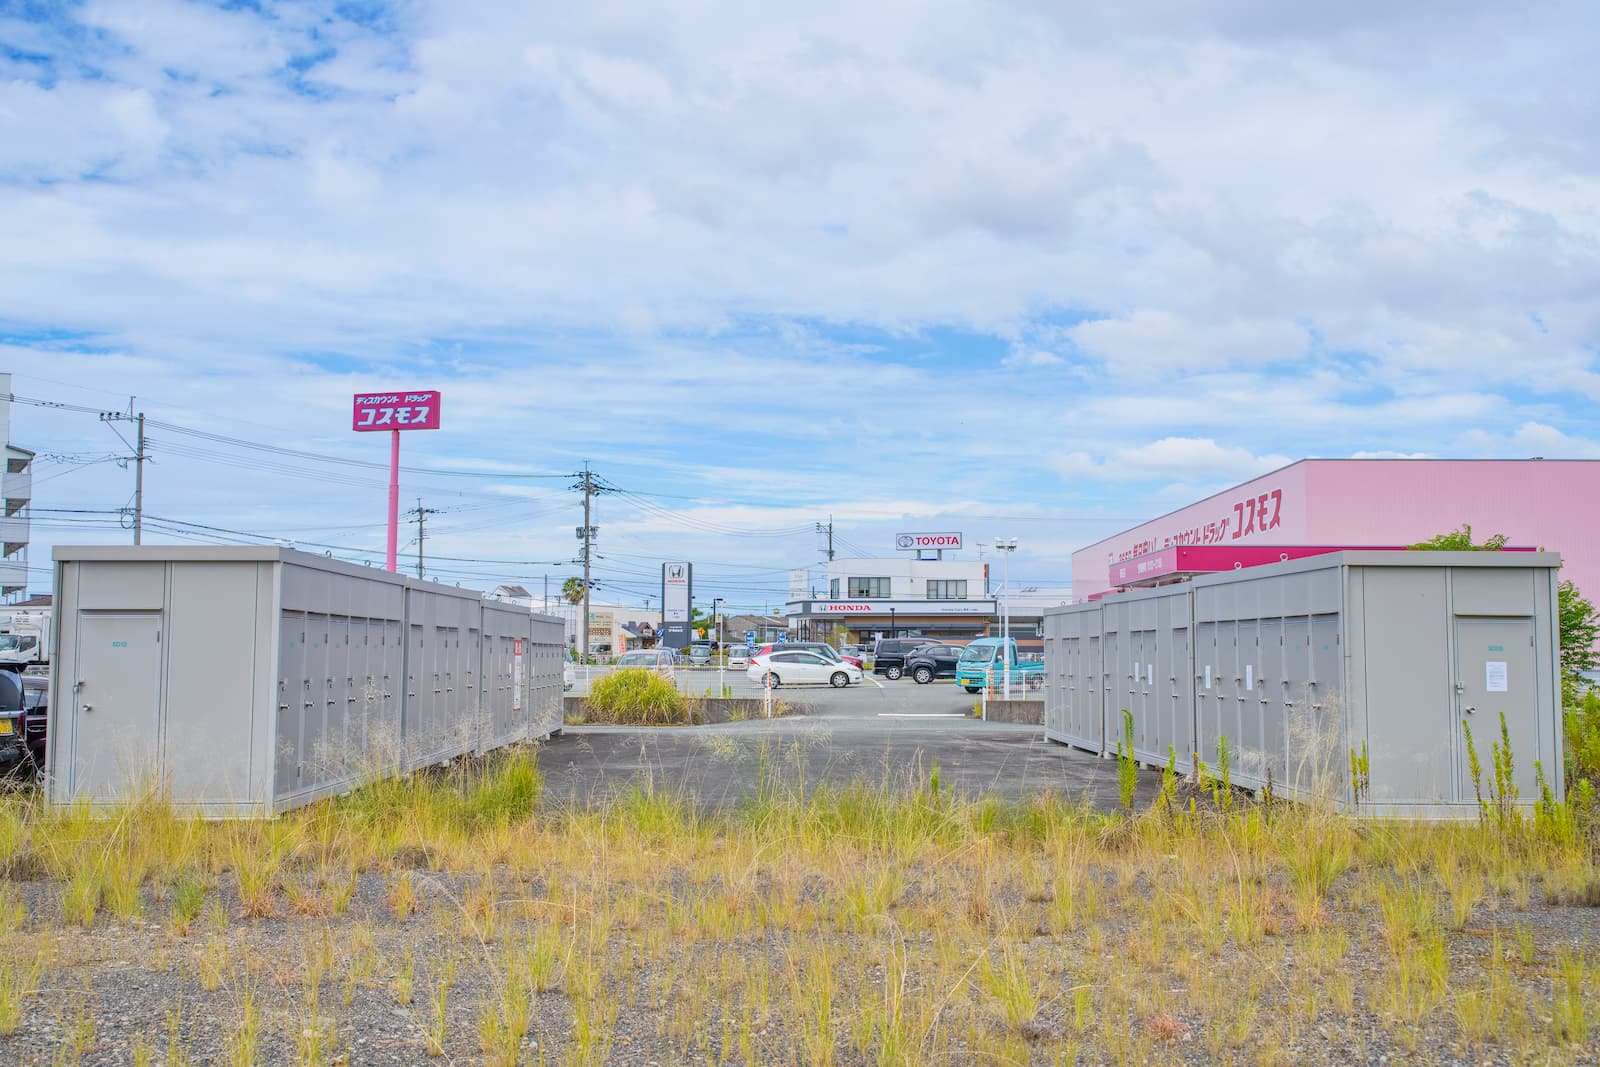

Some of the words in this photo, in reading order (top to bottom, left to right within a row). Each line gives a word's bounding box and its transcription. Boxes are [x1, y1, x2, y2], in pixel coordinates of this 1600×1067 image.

[355, 395, 400, 405] ディスカウント
[404, 394, 433, 403] ドラッグ
[357, 406, 430, 426] コスモス
[1232, 489, 1282, 540] コスモス
[915, 536, 960, 546] TOYOTA
